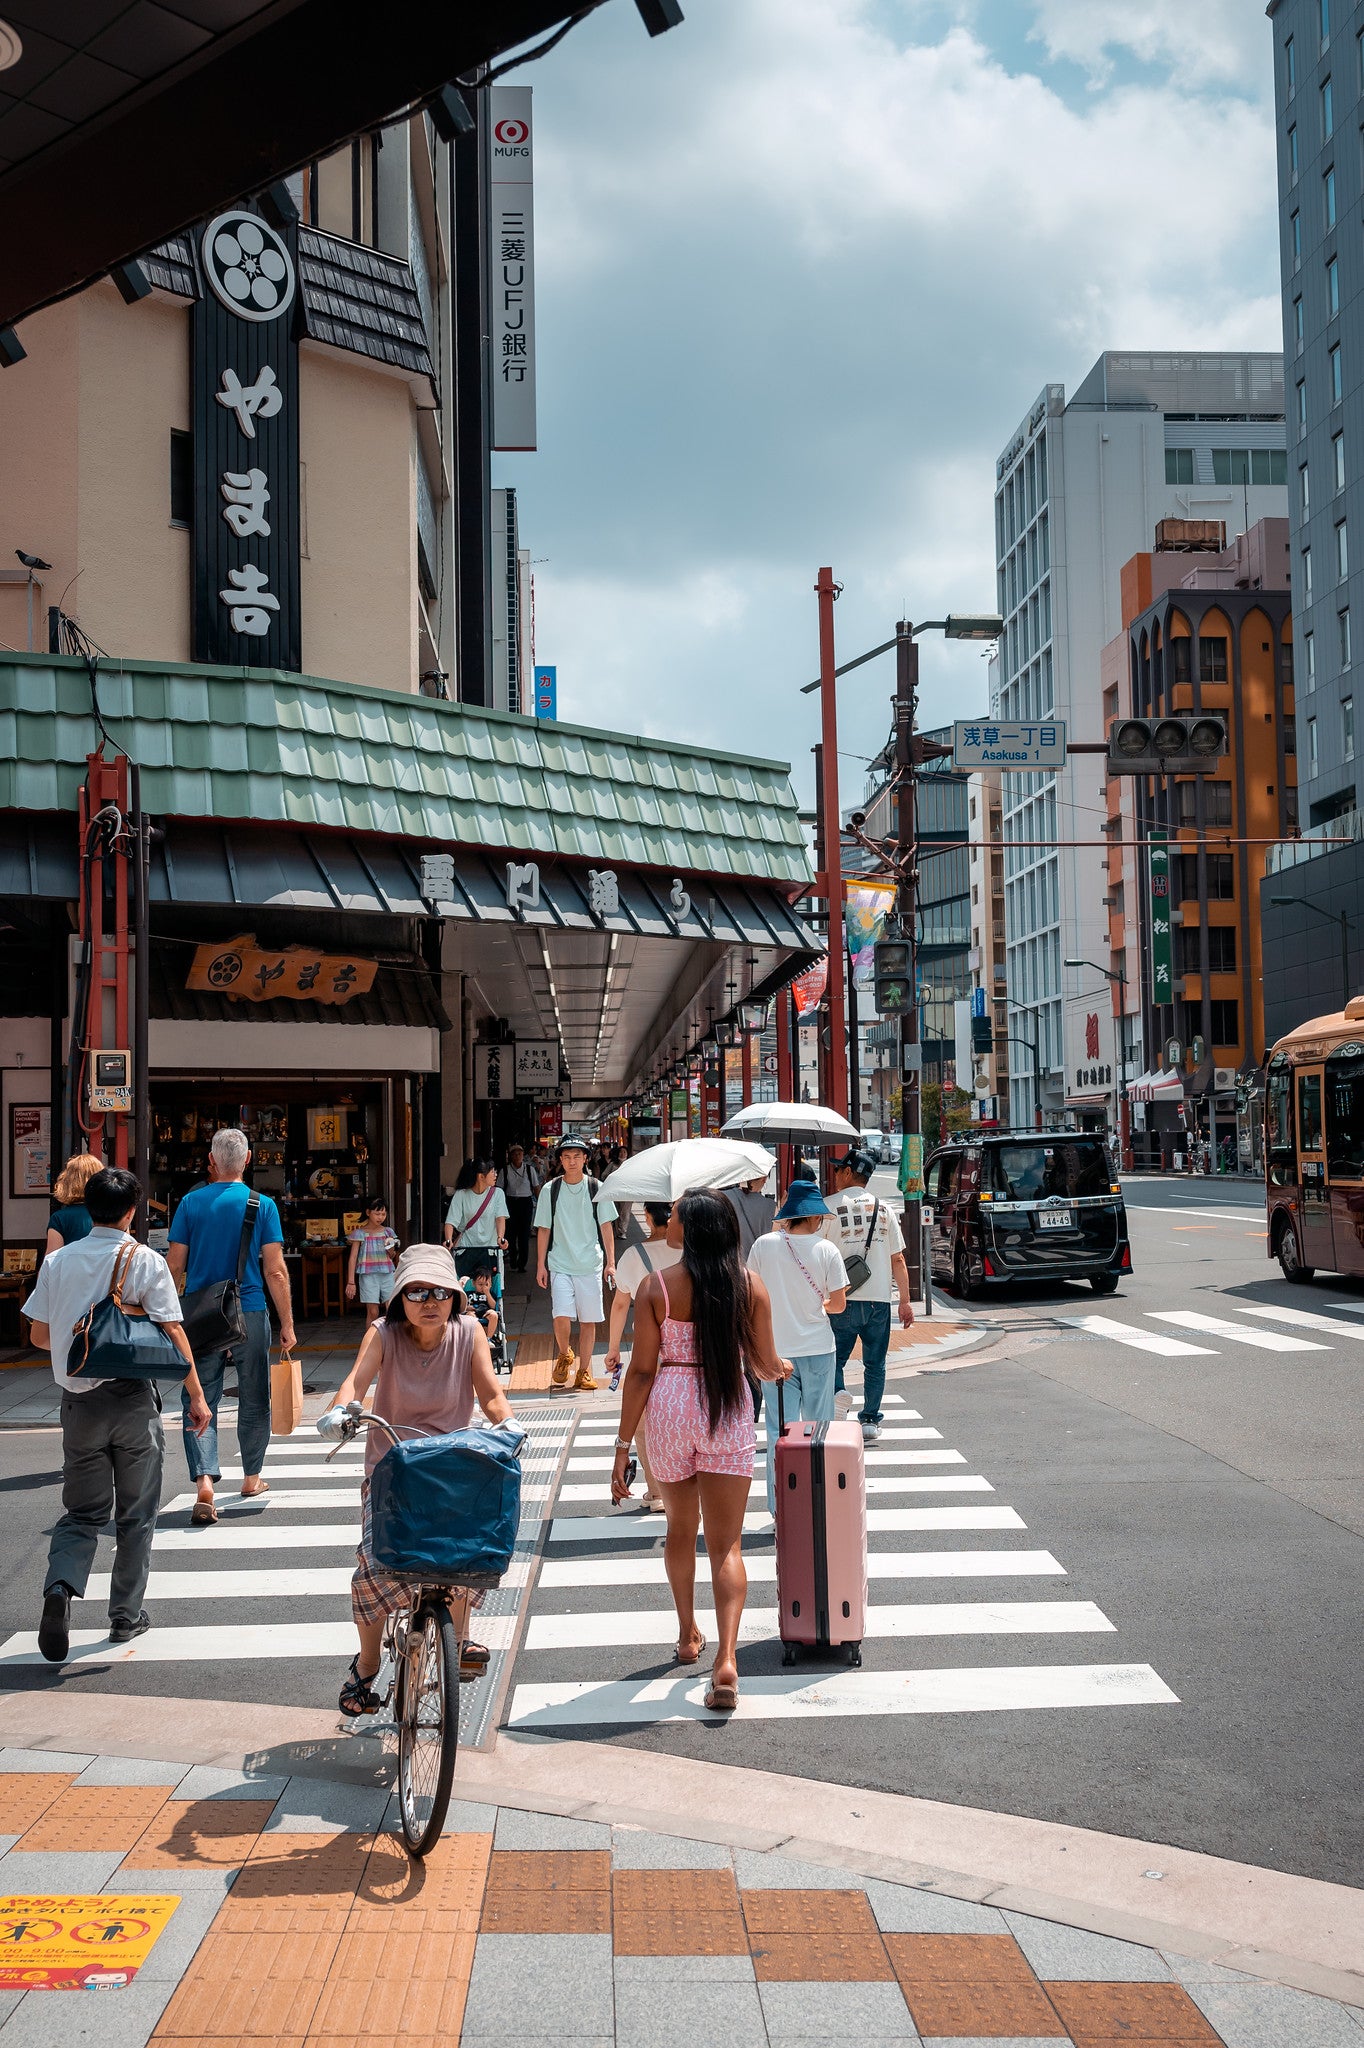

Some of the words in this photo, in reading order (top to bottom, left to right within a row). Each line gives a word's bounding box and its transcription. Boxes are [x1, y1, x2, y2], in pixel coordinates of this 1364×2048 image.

[495, 148, 529, 157] MUFG
[501, 212, 528, 383] 三菱UFJ銀行
[215, 365, 283, 636] やま吉
[539, 676, 552, 720] カラ
[963, 726, 1056, 747] 浅草一丁目
[982, 750, 1028, 760] Asakusa
[1034, 750, 1040, 760] 1
[255, 959, 356, 993] やま吉
